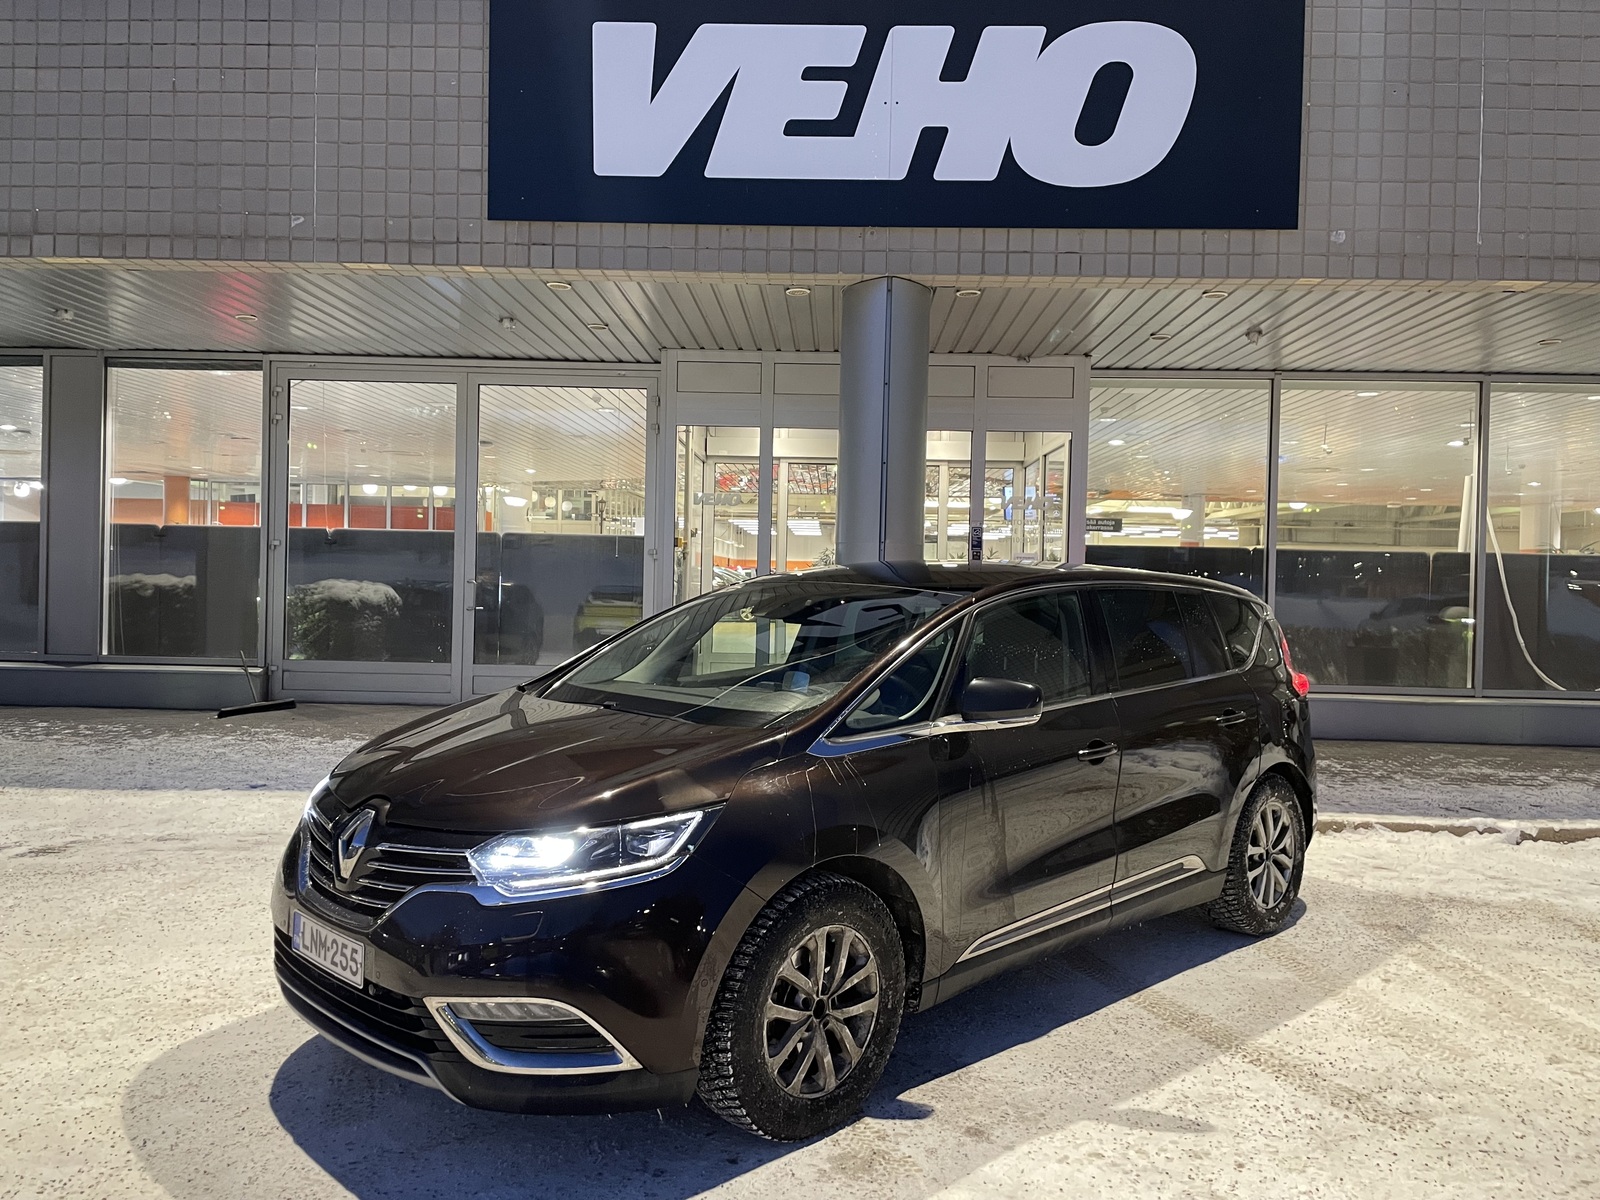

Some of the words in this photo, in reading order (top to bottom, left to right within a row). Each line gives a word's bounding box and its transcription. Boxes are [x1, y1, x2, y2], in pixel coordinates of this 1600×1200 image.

[592, 20, 1197, 188] VEHO
[693, 492, 742, 506] VEHO
[302, 921, 359, 976] LNM-255
